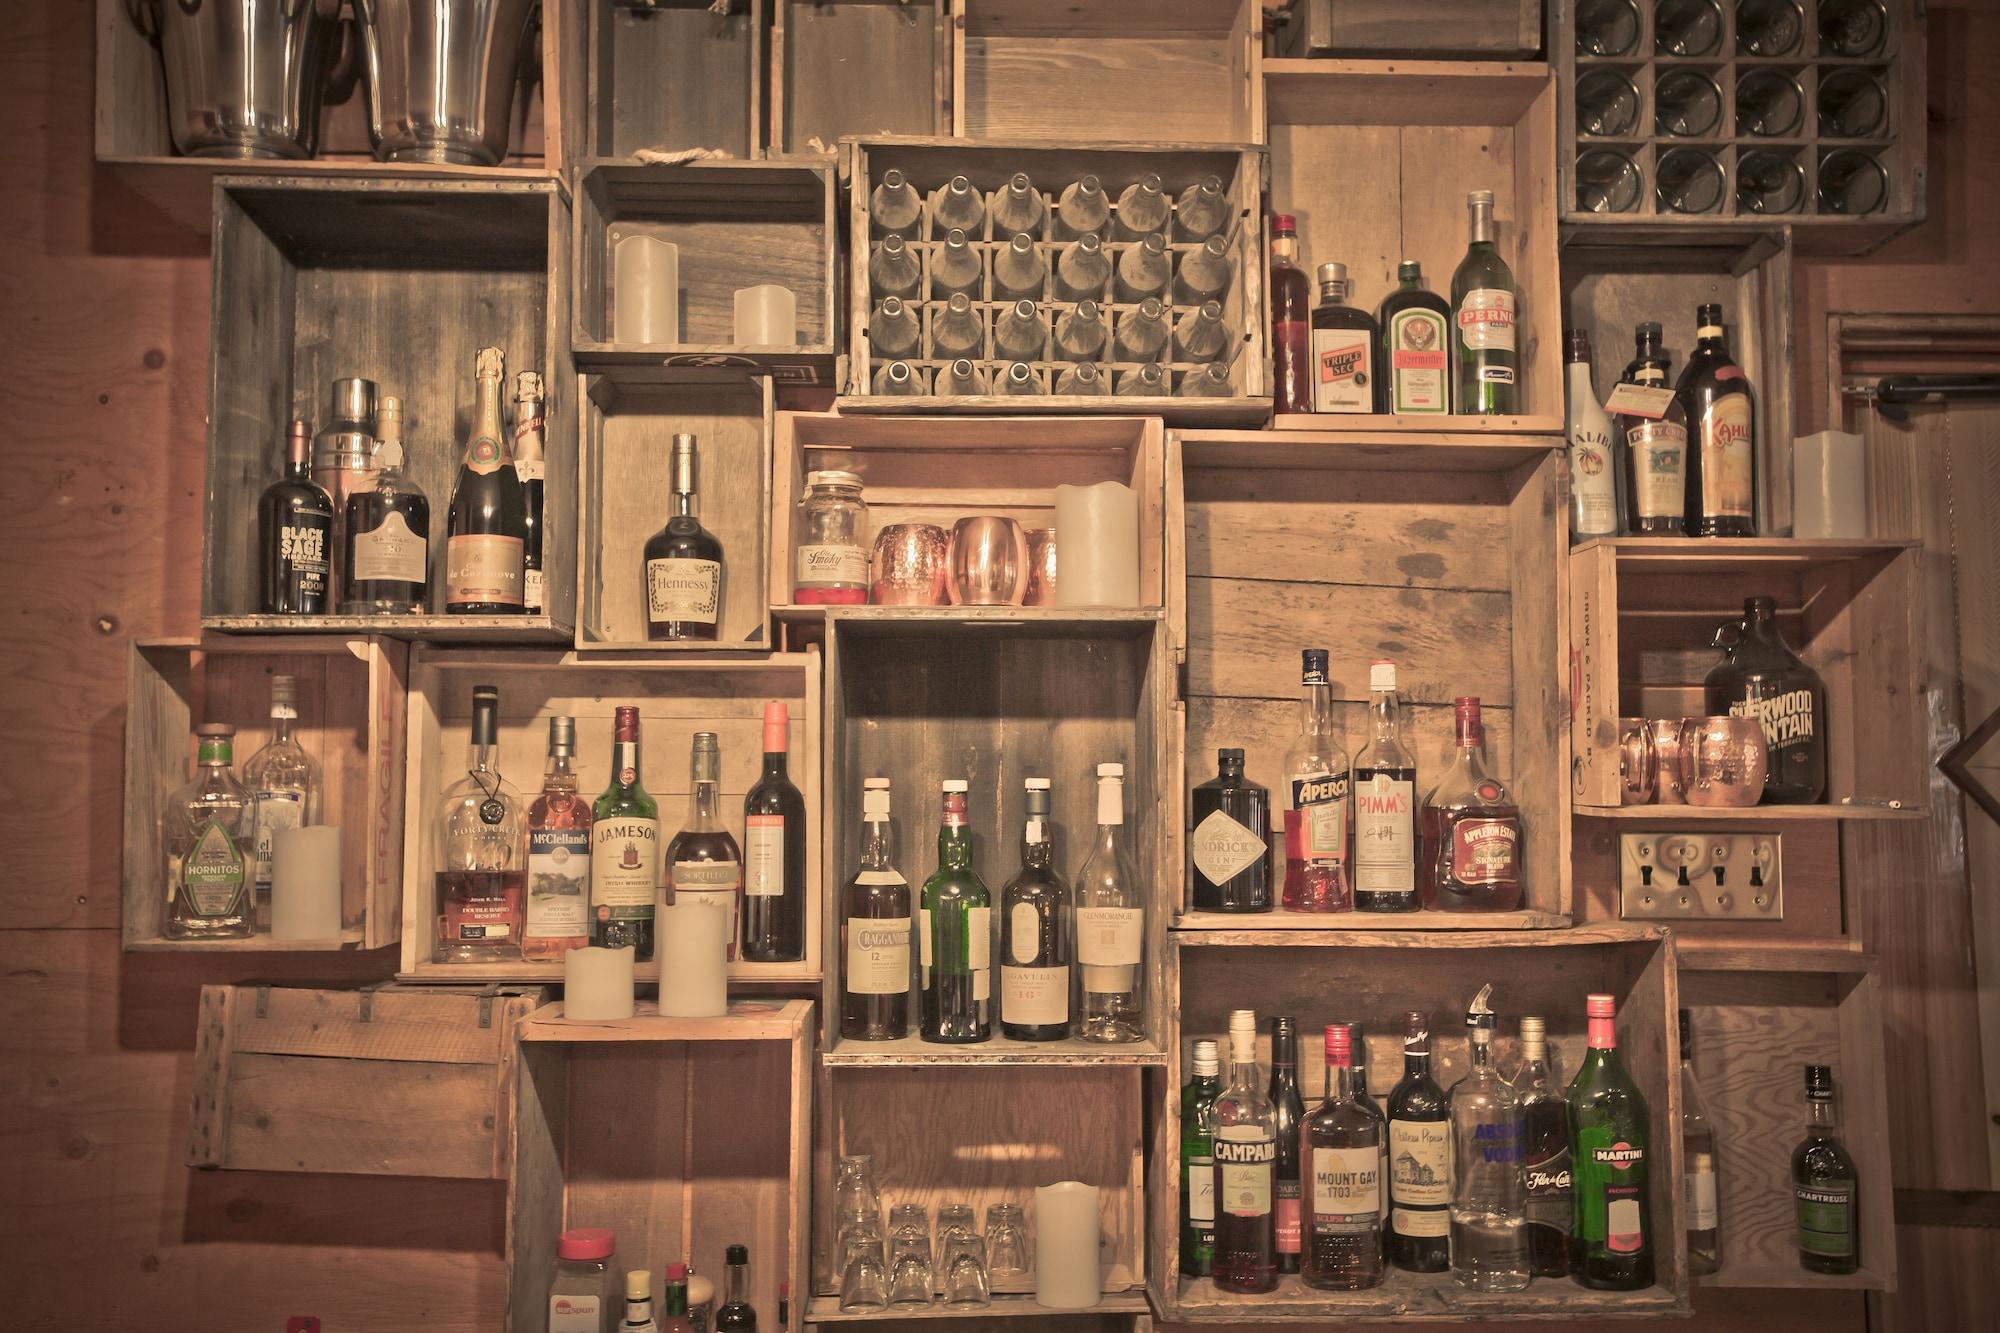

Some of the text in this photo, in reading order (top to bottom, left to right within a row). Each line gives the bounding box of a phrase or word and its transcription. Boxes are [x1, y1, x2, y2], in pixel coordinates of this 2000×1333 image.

[1324, 351, 1361, 367] TRIPLE
[1333, 363, 1353, 375] SEC
[1632, 427, 1663, 440] FOTY
[281, 526, 323, 541] BLACK
[281, 539, 323, 557] SAGE
[807, 552, 842, 567] Smoky
[658, 577, 709, 590] Hennessy
[1585, 673, 1593, 738] PACKED
[1586, 747, 1593, 768] BY
[1300, 779, 1348, 802] APEROL
[1359, 793, 1408, 816] PIMM'S
[454, 825, 488, 836] FORTY
[599, 826, 656, 843] JAMESON
[1464, 826, 1499, 844] APPLETON
[533, 833, 587, 845] McClelland's
[188, 865, 239, 875] HORNITOS
[872, 952, 880, 960] 12
[1215, 1142, 1275, 1161] CAMPARI
[1597, 1150, 1642, 1160] MARTINI
[1317, 1170, 1377, 1185] MOUNT GAY
[1328, 1187, 1350, 1198] 1703
[1797, 1191, 1848, 1203] CHARTREUSE
